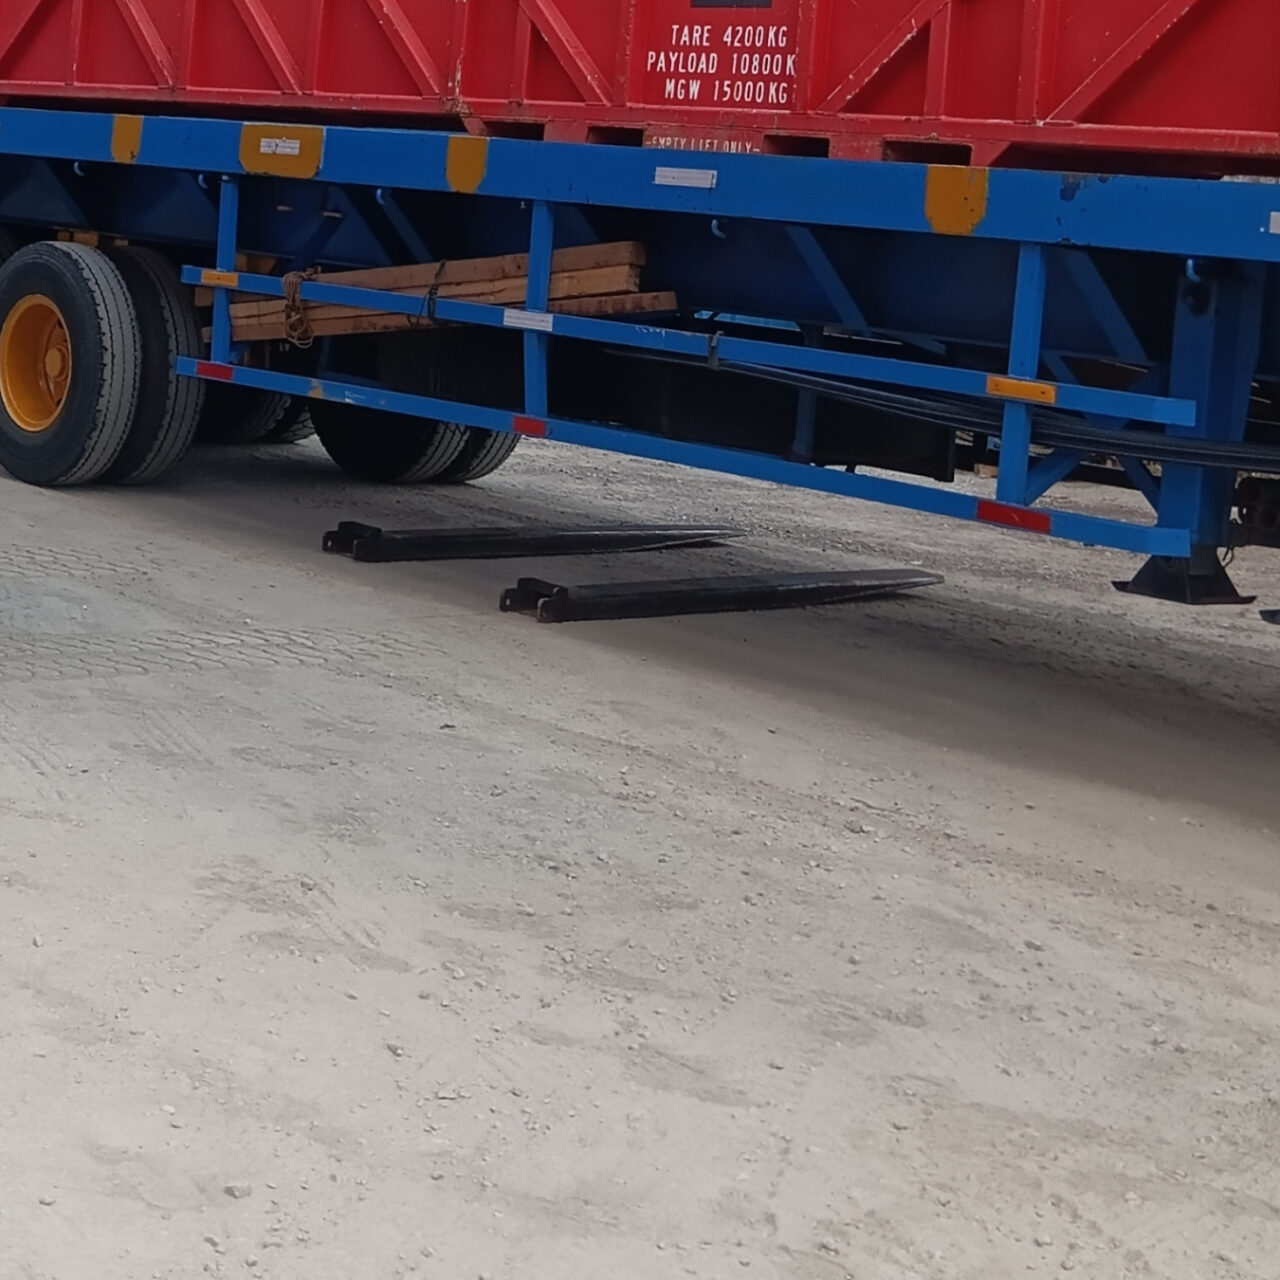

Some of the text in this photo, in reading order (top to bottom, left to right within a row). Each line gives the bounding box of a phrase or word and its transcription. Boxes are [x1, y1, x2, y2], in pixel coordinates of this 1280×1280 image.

[671, 24, 712, 47] TARE
[647, 51, 718, 74] PAYLOAD
[664, 78, 701, 100] MGW
